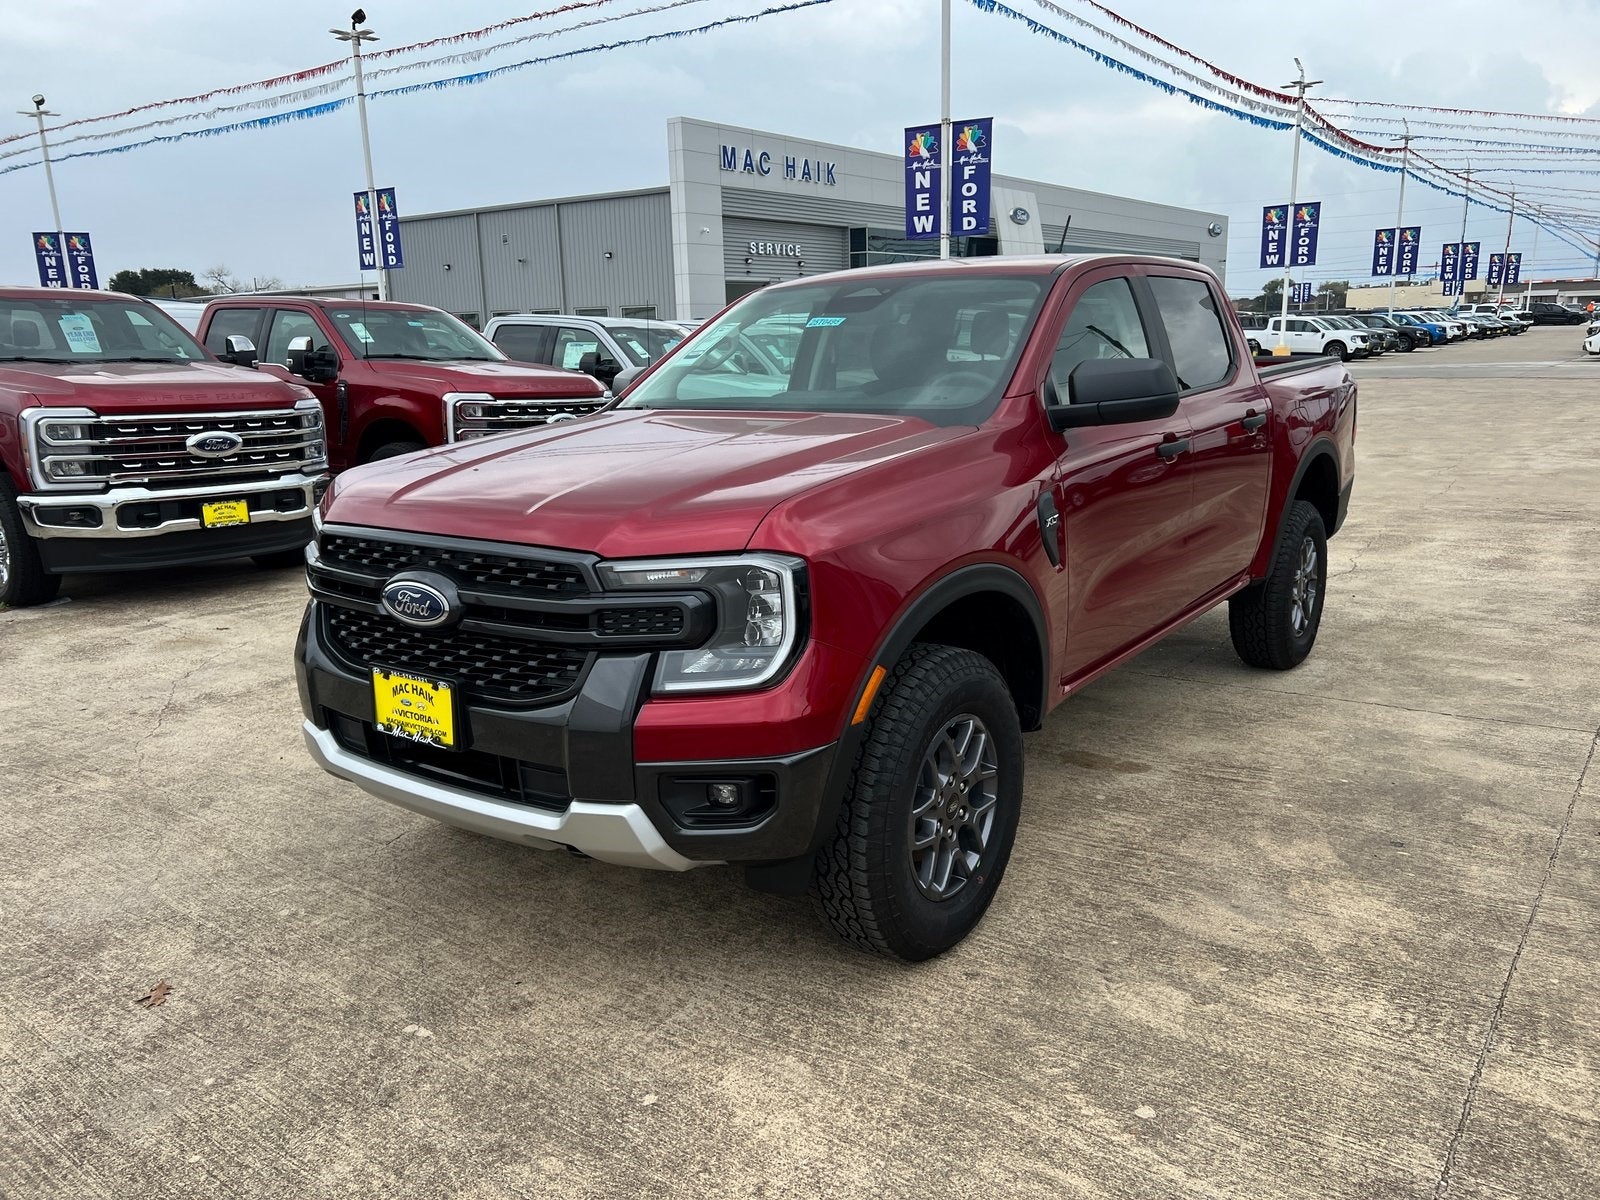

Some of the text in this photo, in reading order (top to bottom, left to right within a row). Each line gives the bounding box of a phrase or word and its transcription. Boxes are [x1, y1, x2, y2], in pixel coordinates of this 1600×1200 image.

[721, 144, 837, 185] MAC HAIK
[913, 171, 934, 233] NEW
[961, 165, 978, 231] FORD
[361, 222, 374, 266] NEW
[385, 220, 397, 266] FORD
[750, 241, 801, 256] SERVICE
[1266, 230, 1279, 265] NEW
[1297, 228, 1310, 264] FORD
[44, 256, 61, 288] NEW
[77, 256, 91, 289] FORD
[1377, 247, 1388, 274] NEW
[1402, 245, 1412, 273] FORD
[1444, 258, 1453, 279] NEW
[1464, 256, 1473, 279] FORD
[1507, 265, 1515, 284] FORD
[204, 438, 230, 451] Ford
[1046, 513, 1059, 527] XLT
[394, 589, 430, 616] Ford
[392, 683, 435, 706] MAC HAIK
[411, 729, 434, 743] Haik
